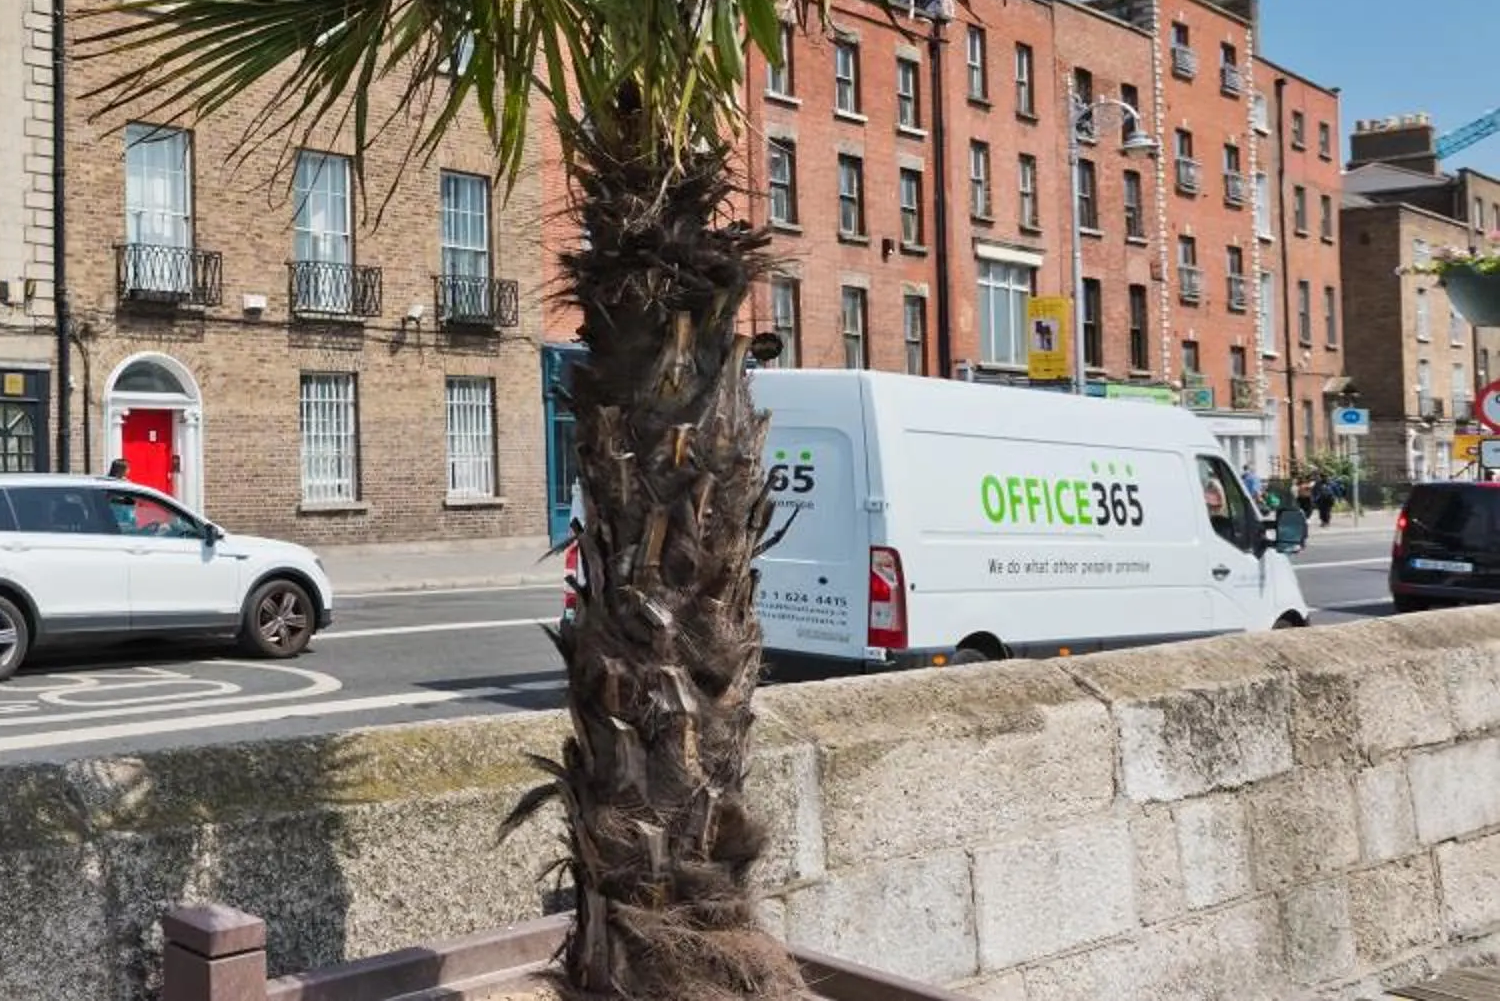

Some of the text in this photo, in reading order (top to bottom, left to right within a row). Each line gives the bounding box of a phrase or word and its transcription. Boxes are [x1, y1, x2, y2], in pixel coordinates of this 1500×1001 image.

[988, 558, 1003, 574] We
[1007, 559, 1021, 574] do
[1024, 559, 1049, 574] what
[1053, 559, 1078, 574] other
